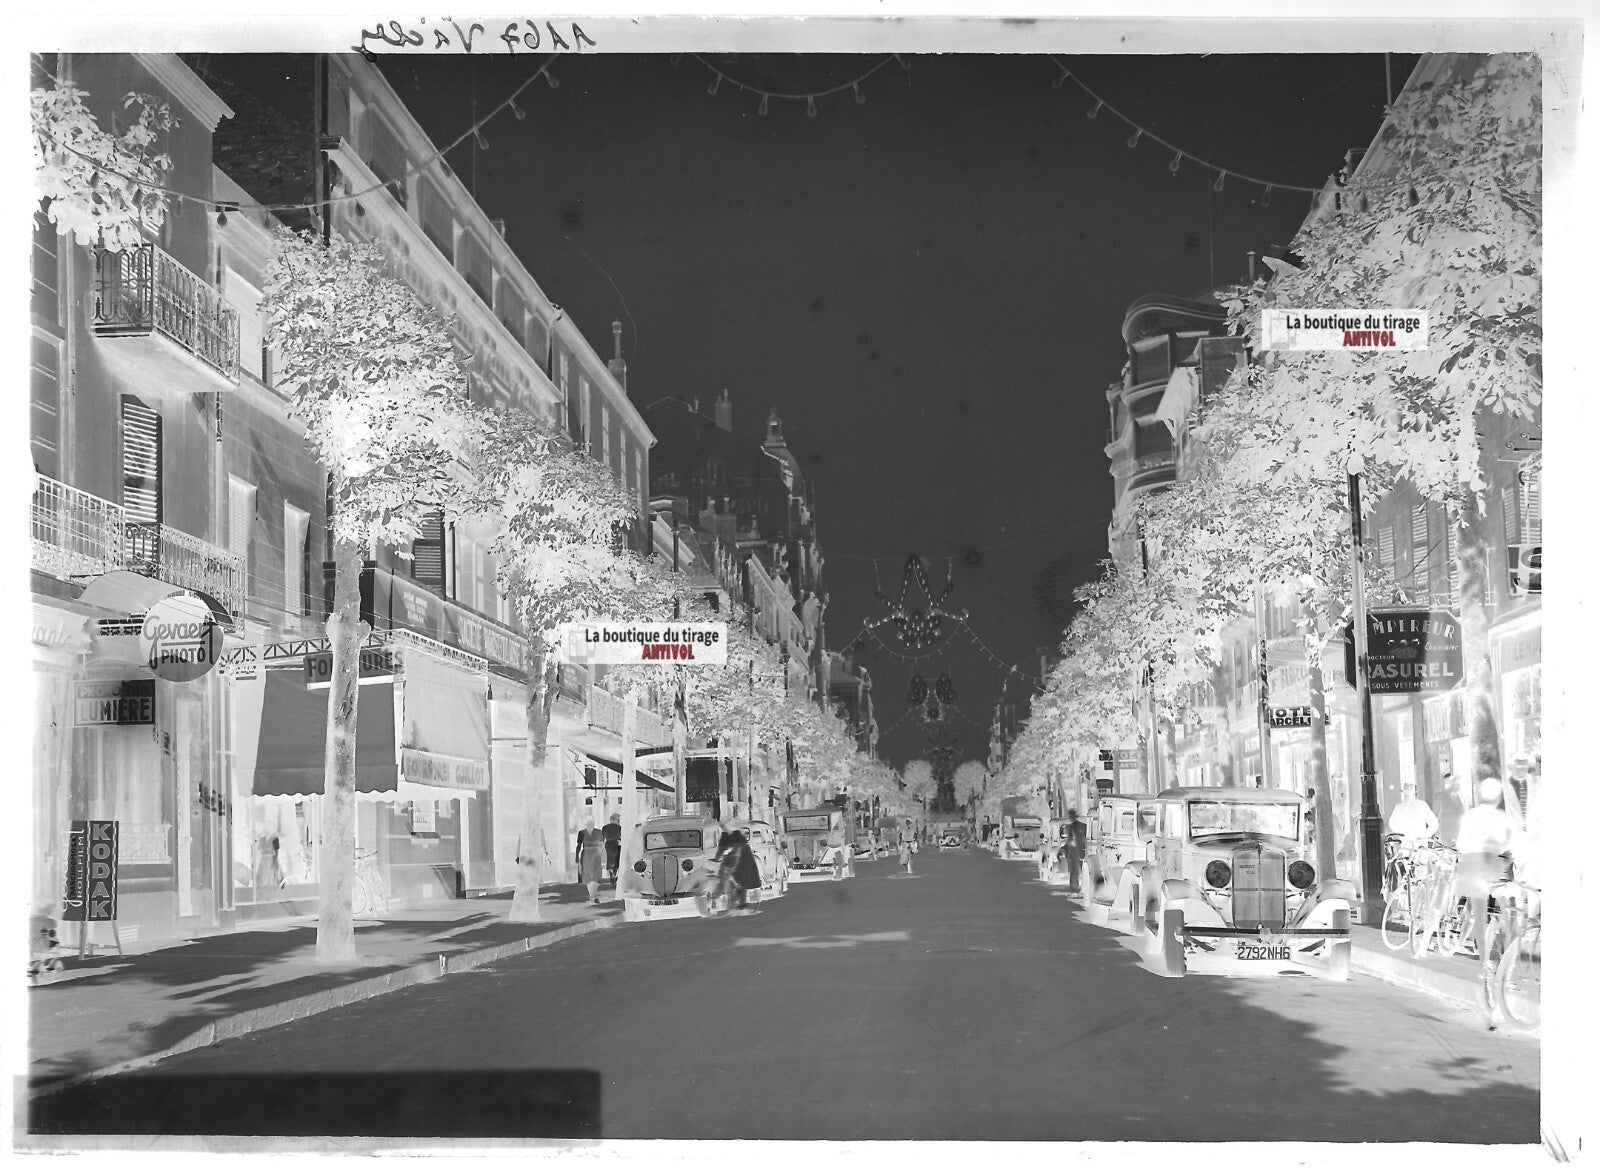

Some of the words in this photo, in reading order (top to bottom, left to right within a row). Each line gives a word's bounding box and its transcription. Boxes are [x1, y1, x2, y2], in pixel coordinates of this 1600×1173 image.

[161, 647, 206, 664] PHOTO
[307, 651, 405, 678] FOURES
[91, 823, 111, 918] KODAK
[1237, 946, 1291, 960] 2792NH6
